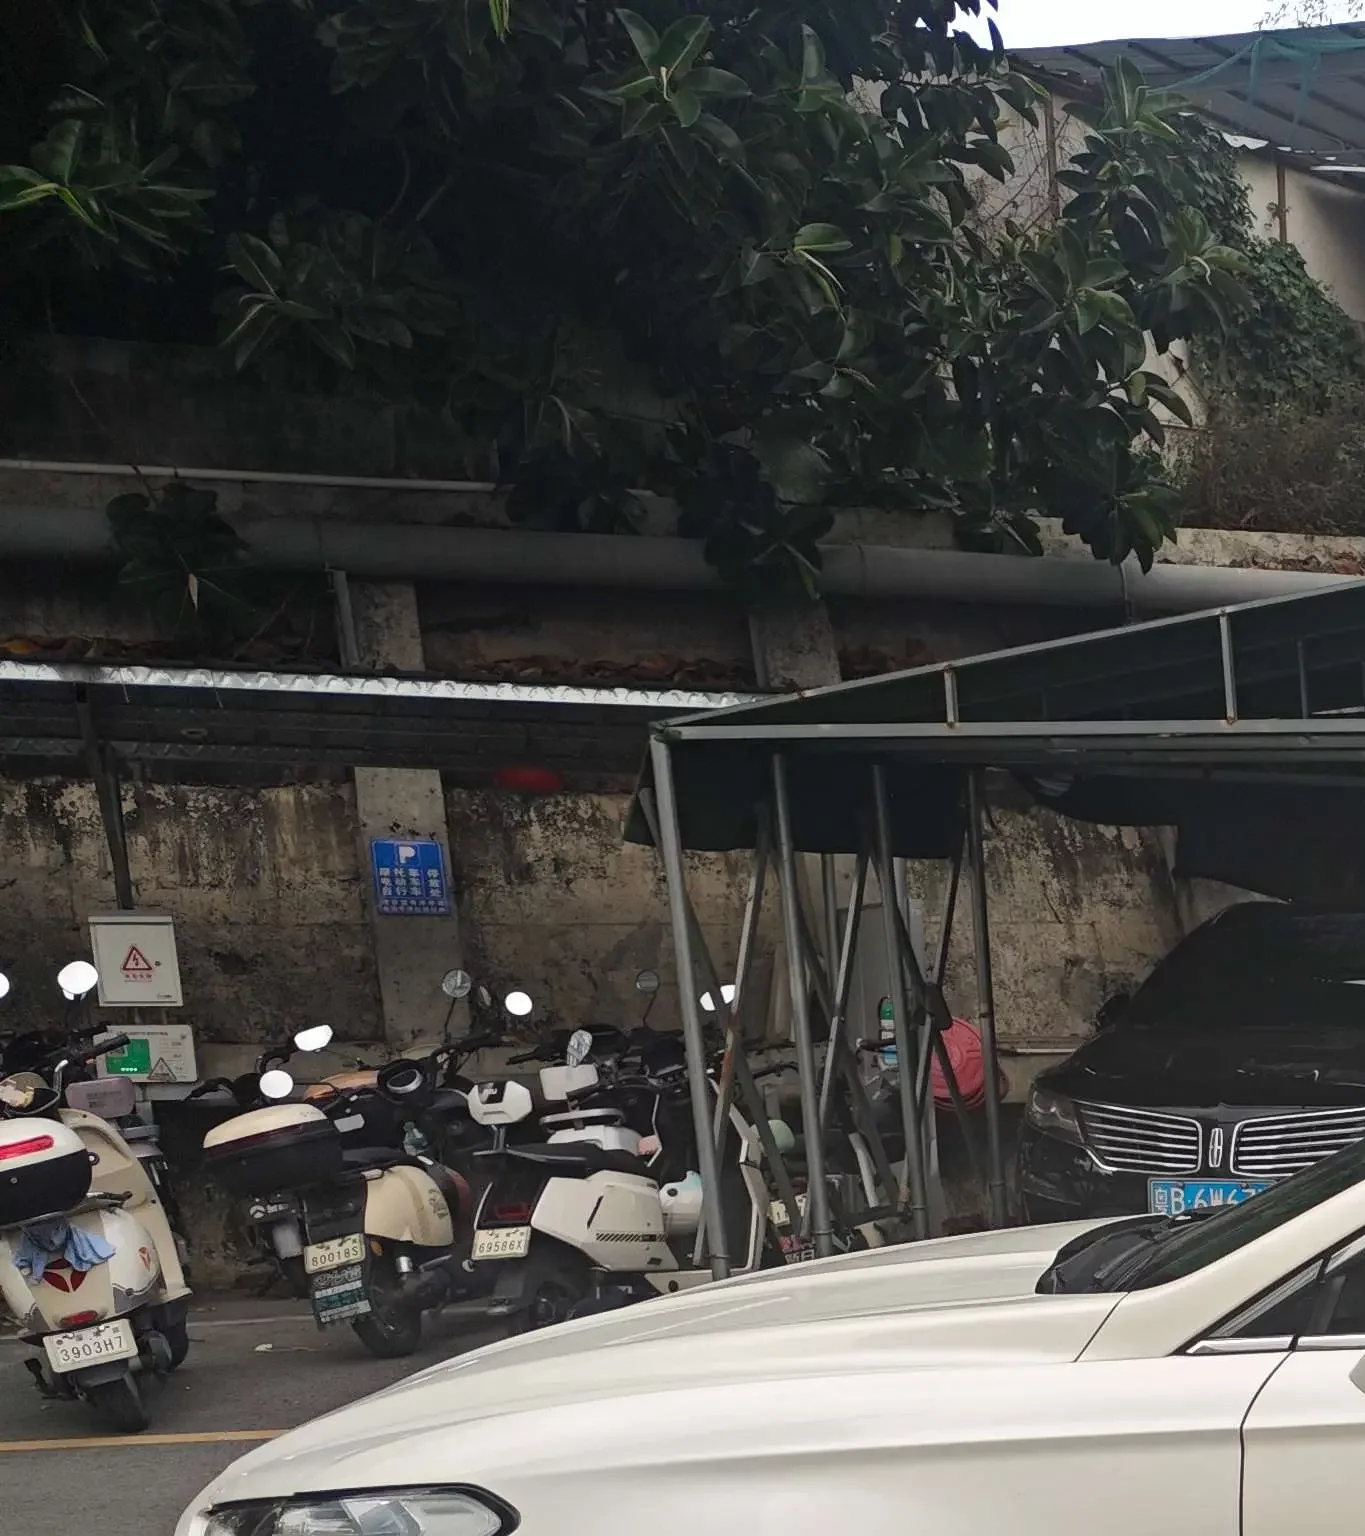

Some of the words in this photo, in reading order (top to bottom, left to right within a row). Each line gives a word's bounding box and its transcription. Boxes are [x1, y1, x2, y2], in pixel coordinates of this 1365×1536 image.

[398, 846, 416, 864] P
[478, 1239, 523, 1254] 69586X
[311, 1246, 360, 1268] 80018S
[60, 1335, 123, 1362] 3903H7
